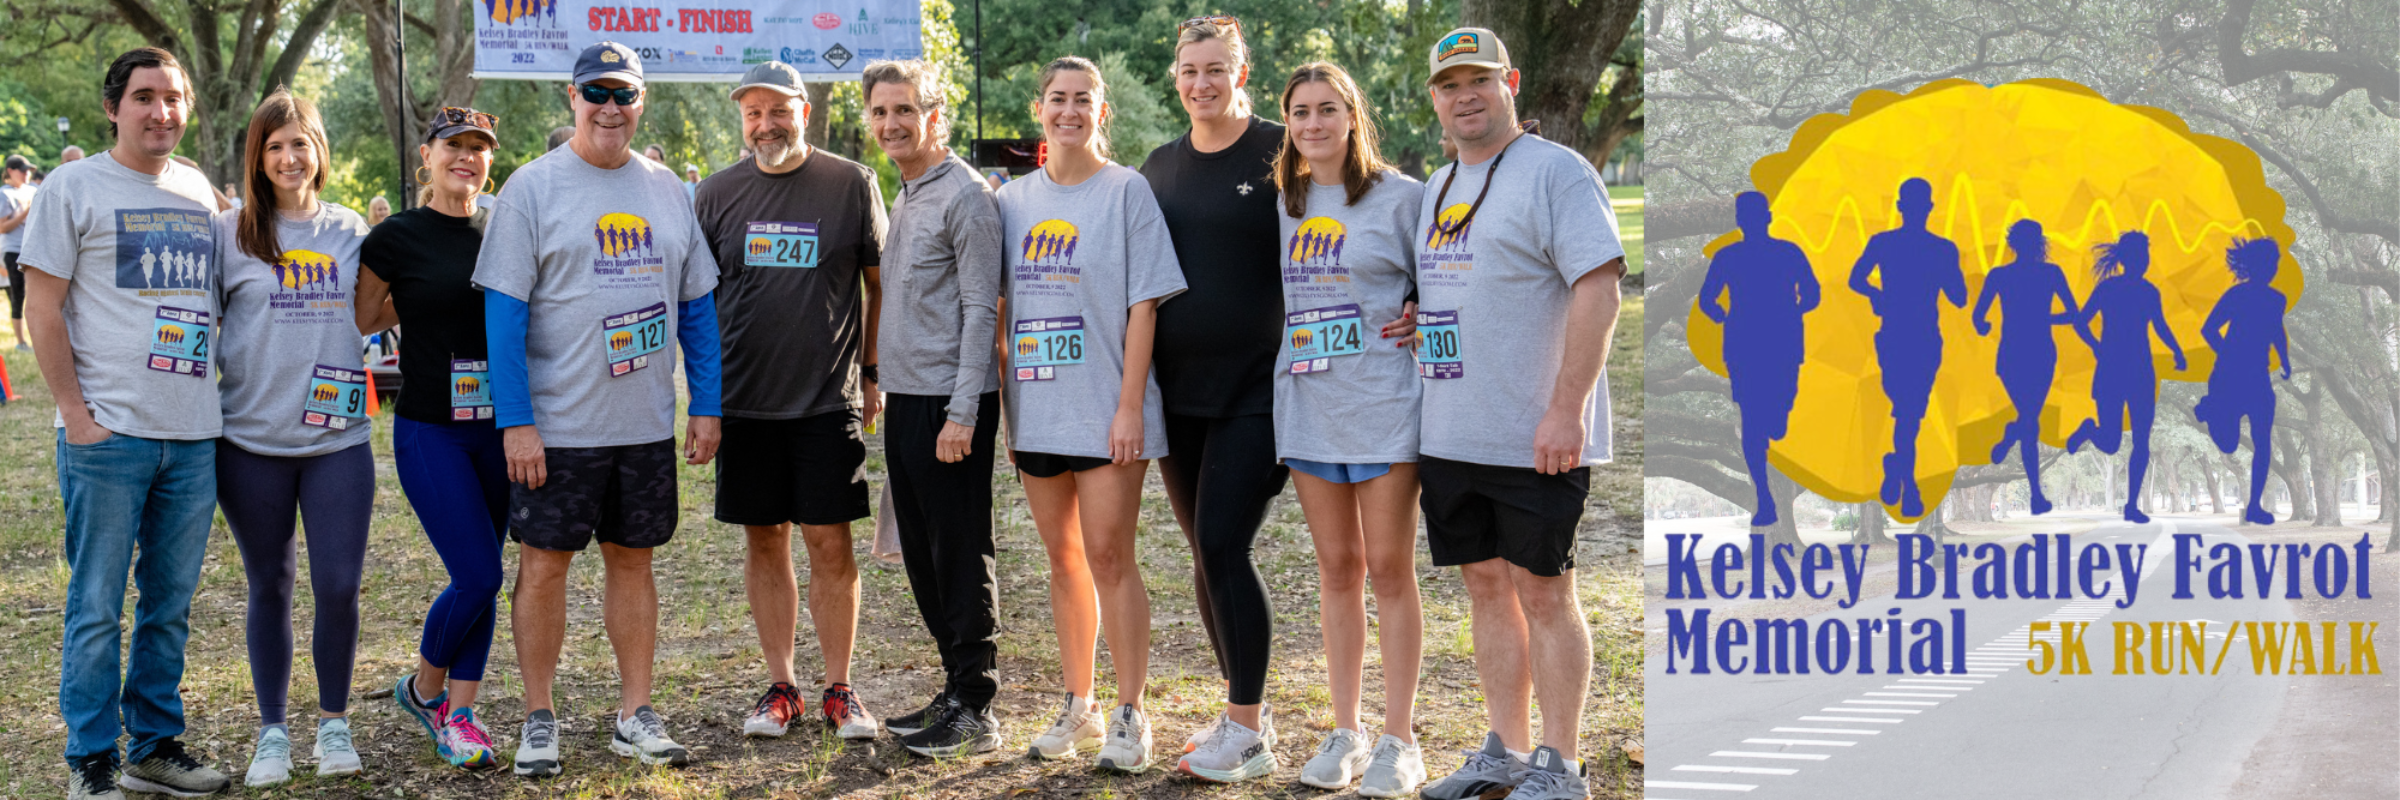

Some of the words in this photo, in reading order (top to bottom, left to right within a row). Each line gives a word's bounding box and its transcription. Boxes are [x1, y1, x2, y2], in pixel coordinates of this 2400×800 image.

[588, 7, 661, 32] START
[678, 9, 753, 33] FINISH
[479, 28, 505, 39] Kelsey
[508, 28, 539, 40] Bradley
[542, 29, 569, 40] Favrot
[480, 39, 518, 50] Memorial
[511, 52, 535, 64] 2022
[123, 213, 151, 223] Kelsey
[125, 222, 165, 233] Memorial
[776, 238, 816, 264] 247
[615, 258, 641, 267] Bradley
[269, 292, 294, 301] Kelsey
[296, 292, 324, 301] Bradley
[270, 301, 305, 309] Memorial
[638, 318, 666, 351] 127
[1319, 322, 1361, 353] 124
[1044, 334, 1082, 361] 126
[1426, 329, 1457, 359] 130
[1240, 741, 1265, 762] HOKA
